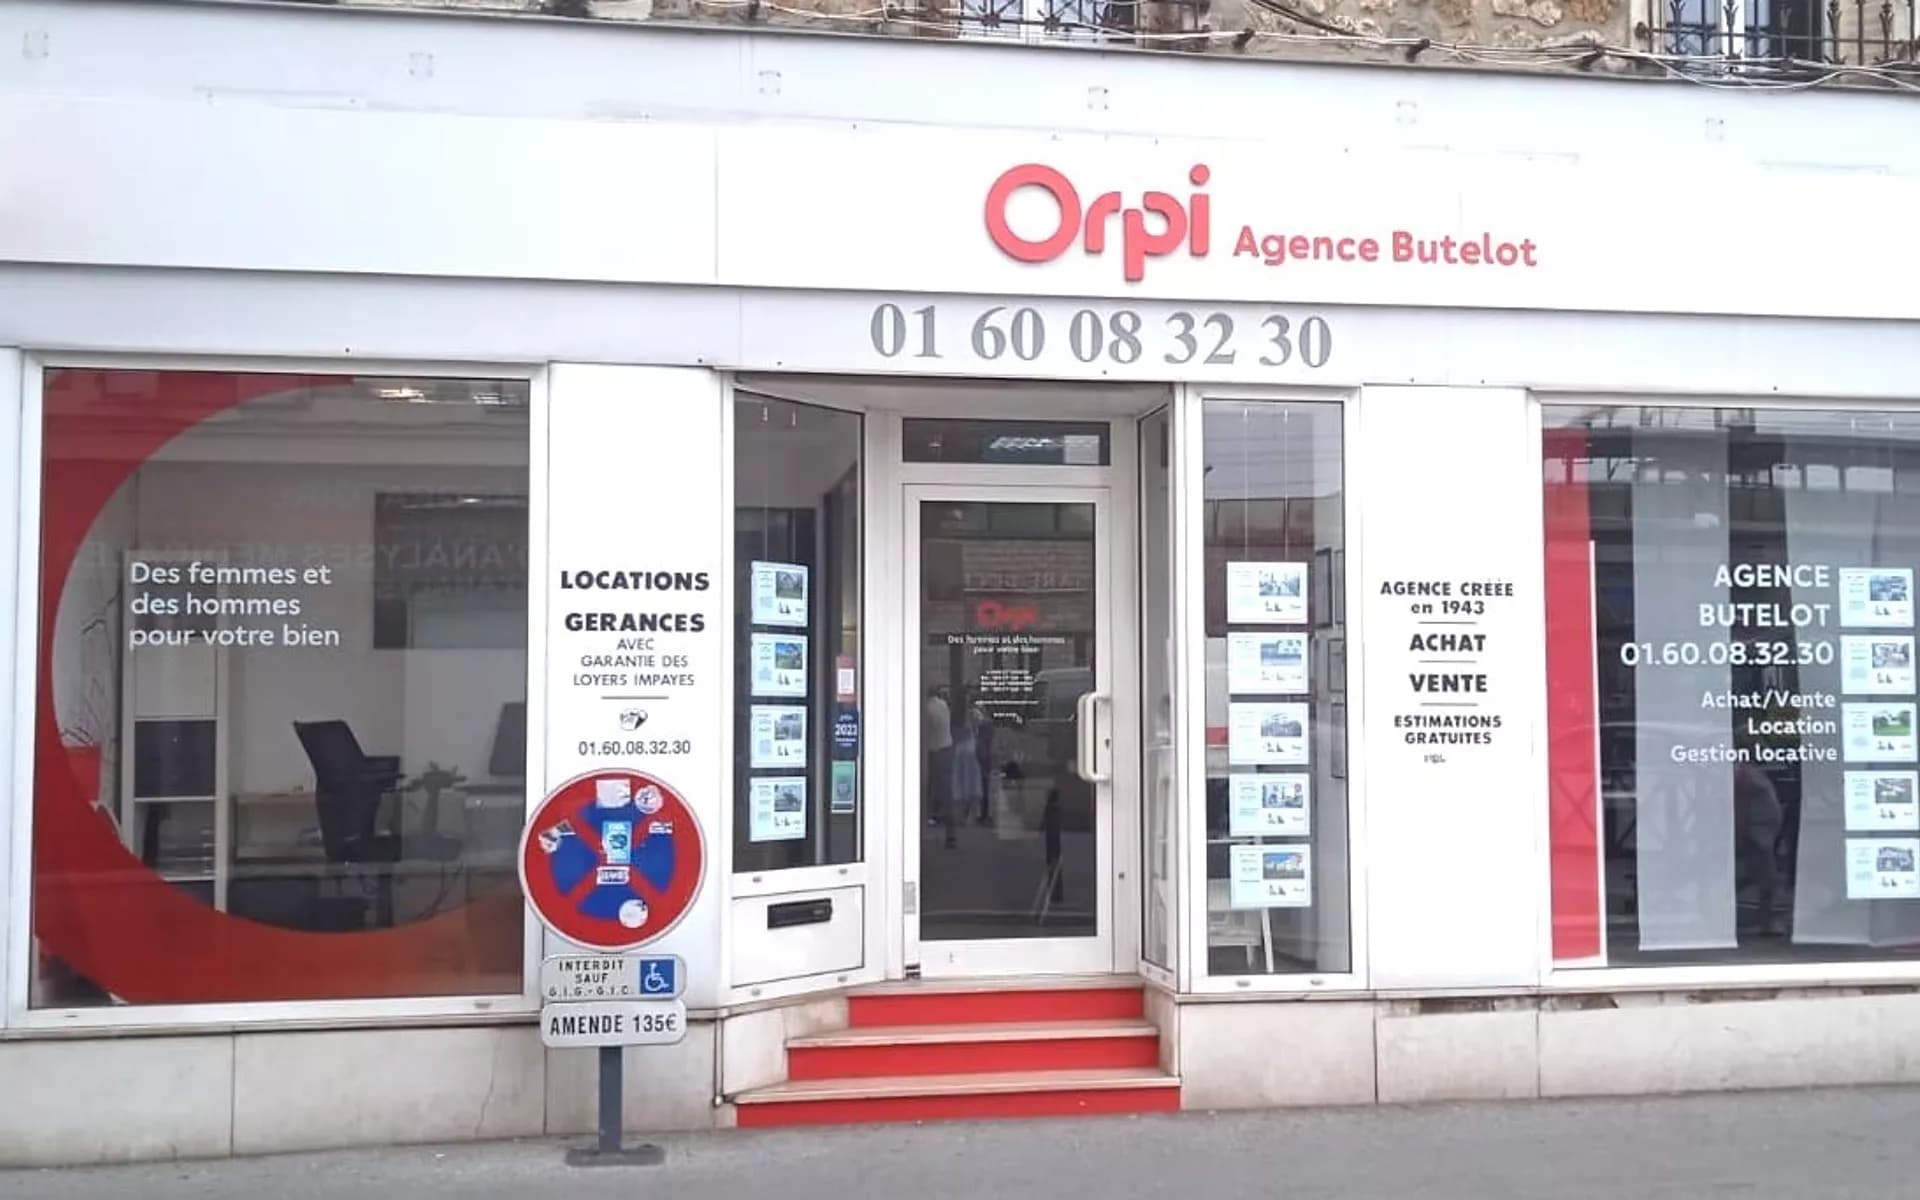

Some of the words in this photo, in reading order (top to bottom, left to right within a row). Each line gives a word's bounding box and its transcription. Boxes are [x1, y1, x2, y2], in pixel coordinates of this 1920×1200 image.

[986, 165, 1209, 279] Orpi
[1234, 225, 1378, 265] Agence
[1393, 231, 1537, 267] Butelot
[869, 301, 945, 358] 01
[970, 304, 1046, 361] 60
[1069, 307, 1143, 364] 08
[1163, 310, 1238, 366] 32
[1259, 313, 1333, 369] 30
[131, 562, 180, 584] Des
[188, 562, 296, 584] femmes
[303, 565, 331, 584] et
[561, 571, 709, 591] LOCATIONS
[1714, 564, 1829, 587] AGENCE
[1381, 582, 1450, 596] AGENCE
[130, 592, 179, 614] des
[187, 592, 300, 615] hommes
[1411, 604, 1432, 614] en
[1442, 601, 1484, 614] 1943
[565, 613, 704, 632] GERANCES
[1700, 603, 1830, 627] BUTELOT
[129, 630, 195, 650] pour
[202, 626, 274, 645] votre
[283, 624, 339, 645] bien
[617, 638, 654, 650] AVEC
[1410, 634, 1486, 651] ACHAT
[581, 655, 654, 667] GARANTIE
[662, 655, 688, 667] DES
[1620, 641, 1833, 666] 01.60.08.32.30
[574, 674, 627, 685] LOYERS
[635, 674, 694, 685] IMPAYES
[1410, 674, 1487, 692] VENTE
[1702, 689, 1835, 709] Achat/Vente
[1395, 715, 1501, 728] ESTIMATIONS
[1747, 716, 1836, 735] Location
[579, 740, 690, 755] 01.60.08.32.30
[1405, 732, 1491, 744] GRATUITES
[1672, 744, 1749, 762] Gestion
[1755, 743, 1837, 762] locative
[558, 959, 625, 972] INTERDIT
[575, 973, 609, 984] SAUF
[550, 1014, 624, 1036] AMENDE
[632, 1013, 678, 1033] 135€
